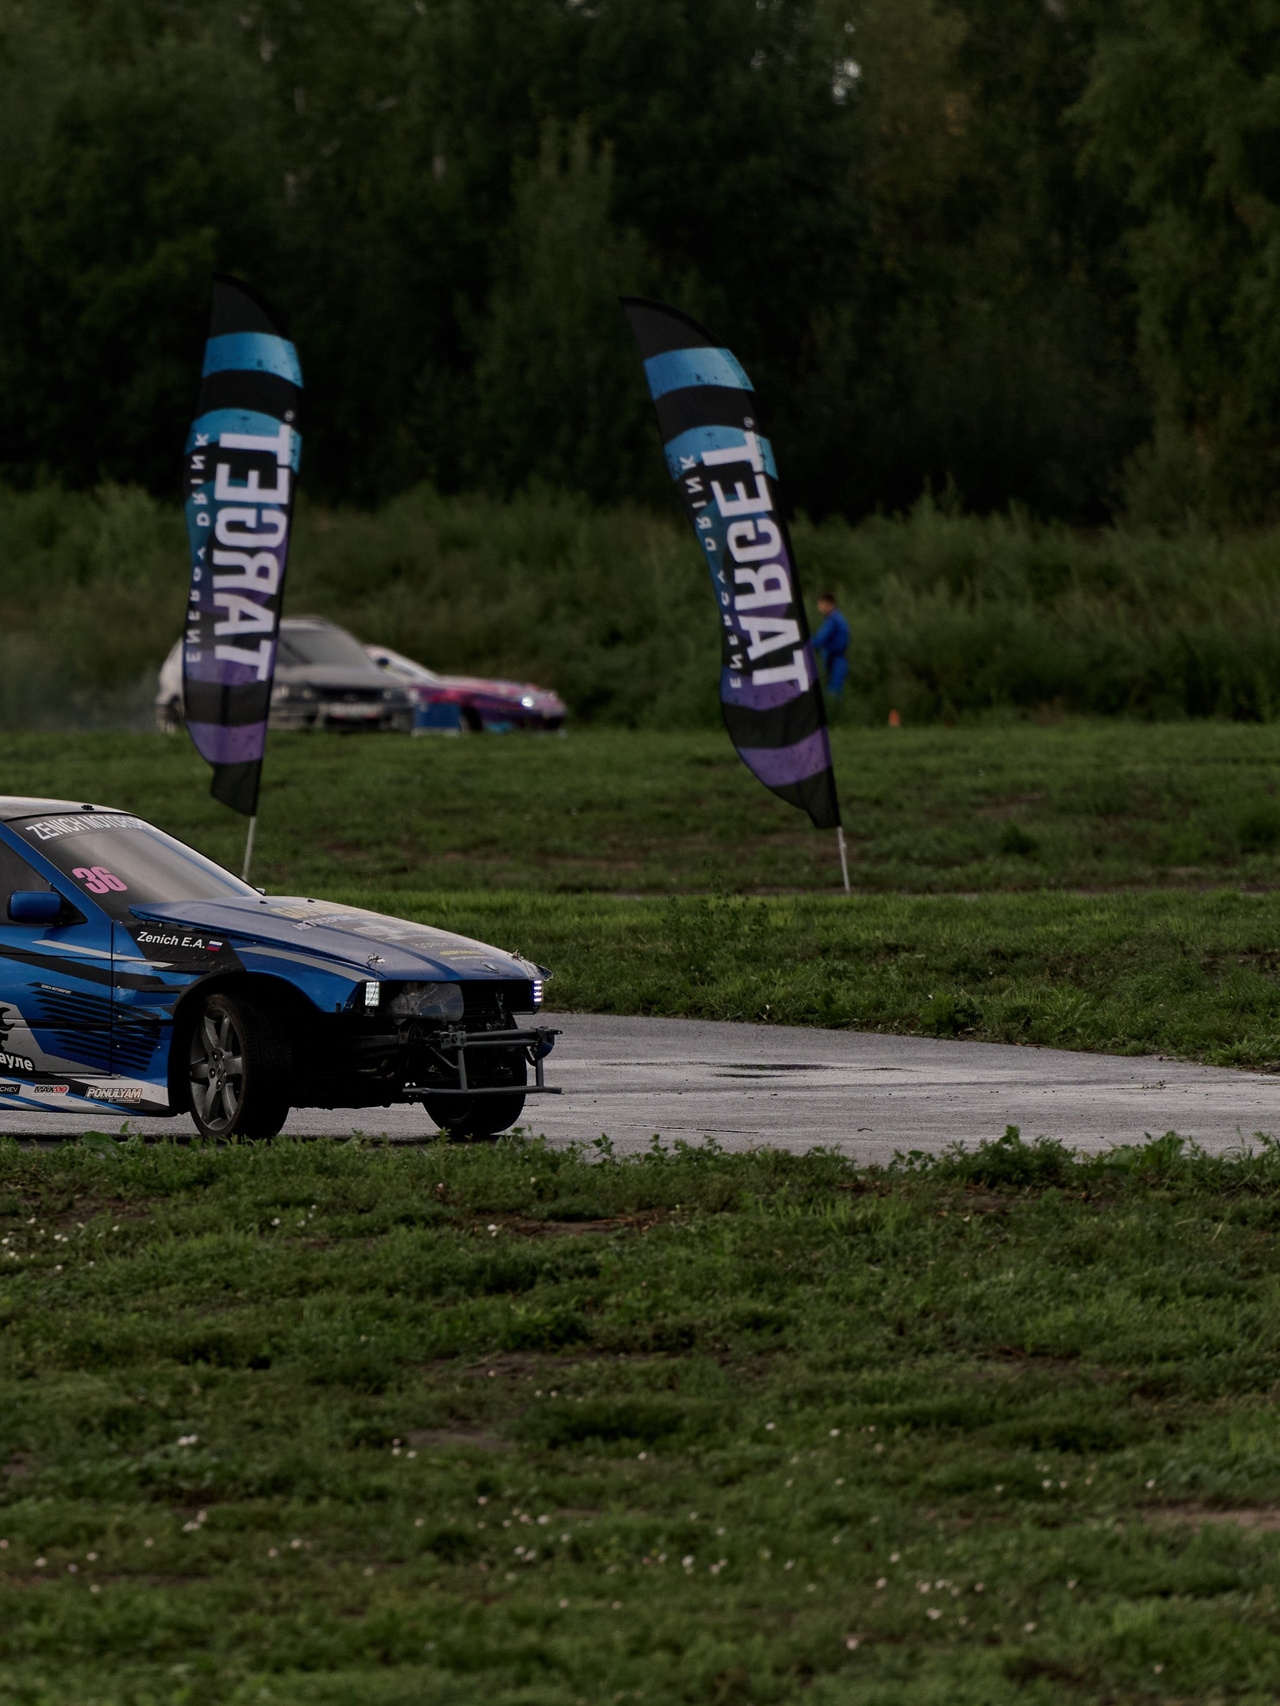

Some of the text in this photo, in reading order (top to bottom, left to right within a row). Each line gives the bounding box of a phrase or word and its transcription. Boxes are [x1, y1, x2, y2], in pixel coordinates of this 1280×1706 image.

[25, 815, 90, 841] ZENICH
[71, 866, 129, 894] 36
[137, 931, 206, 949] Zenich E.A.
